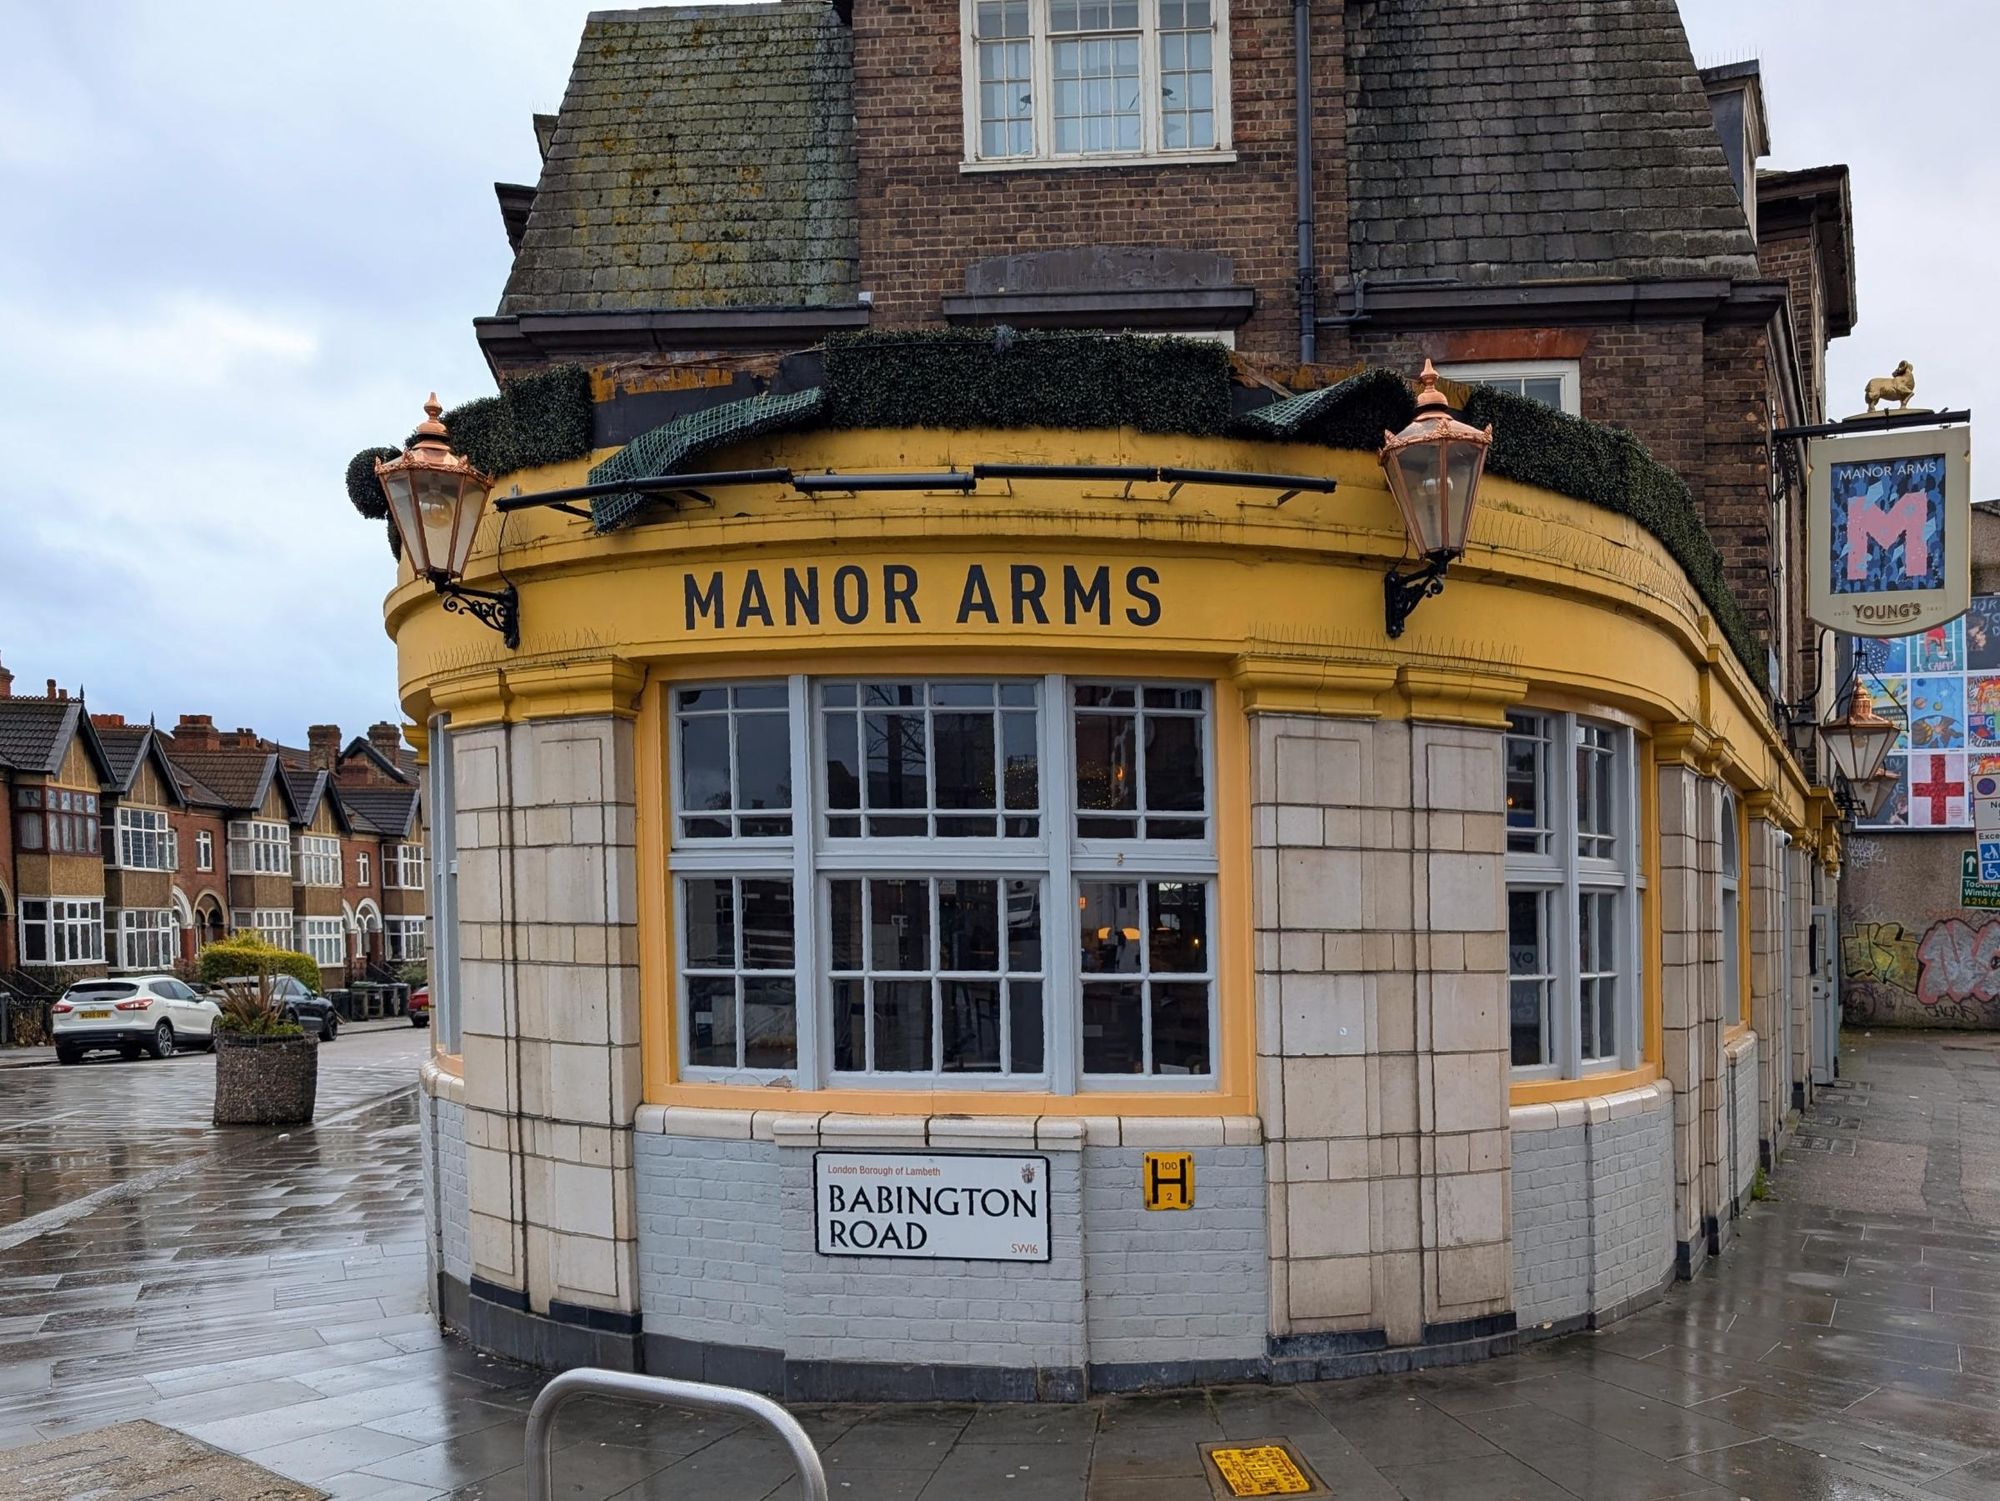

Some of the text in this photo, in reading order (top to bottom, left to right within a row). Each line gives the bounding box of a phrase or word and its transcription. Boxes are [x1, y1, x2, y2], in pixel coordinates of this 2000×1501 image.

[1839, 462, 1937, 480] MANOR ARMS
[1847, 489, 1928, 580] M
[683, 563, 1162, 631] MANOR ARMS
[1852, 602, 1922, 619] YOUNG'S
[827, 1164, 941, 1177] London Borough of Lambeth
[1160, 1161, 1178, 1170] 100
[1151, 1158, 1187, 1204] H
[828, 1184, 1038, 1218] BABINGTON
[1166, 1192, 1173, 1201] 2
[829, 1219, 928, 1250] ROAD
[1011, 1243, 1039, 1254] SW16
